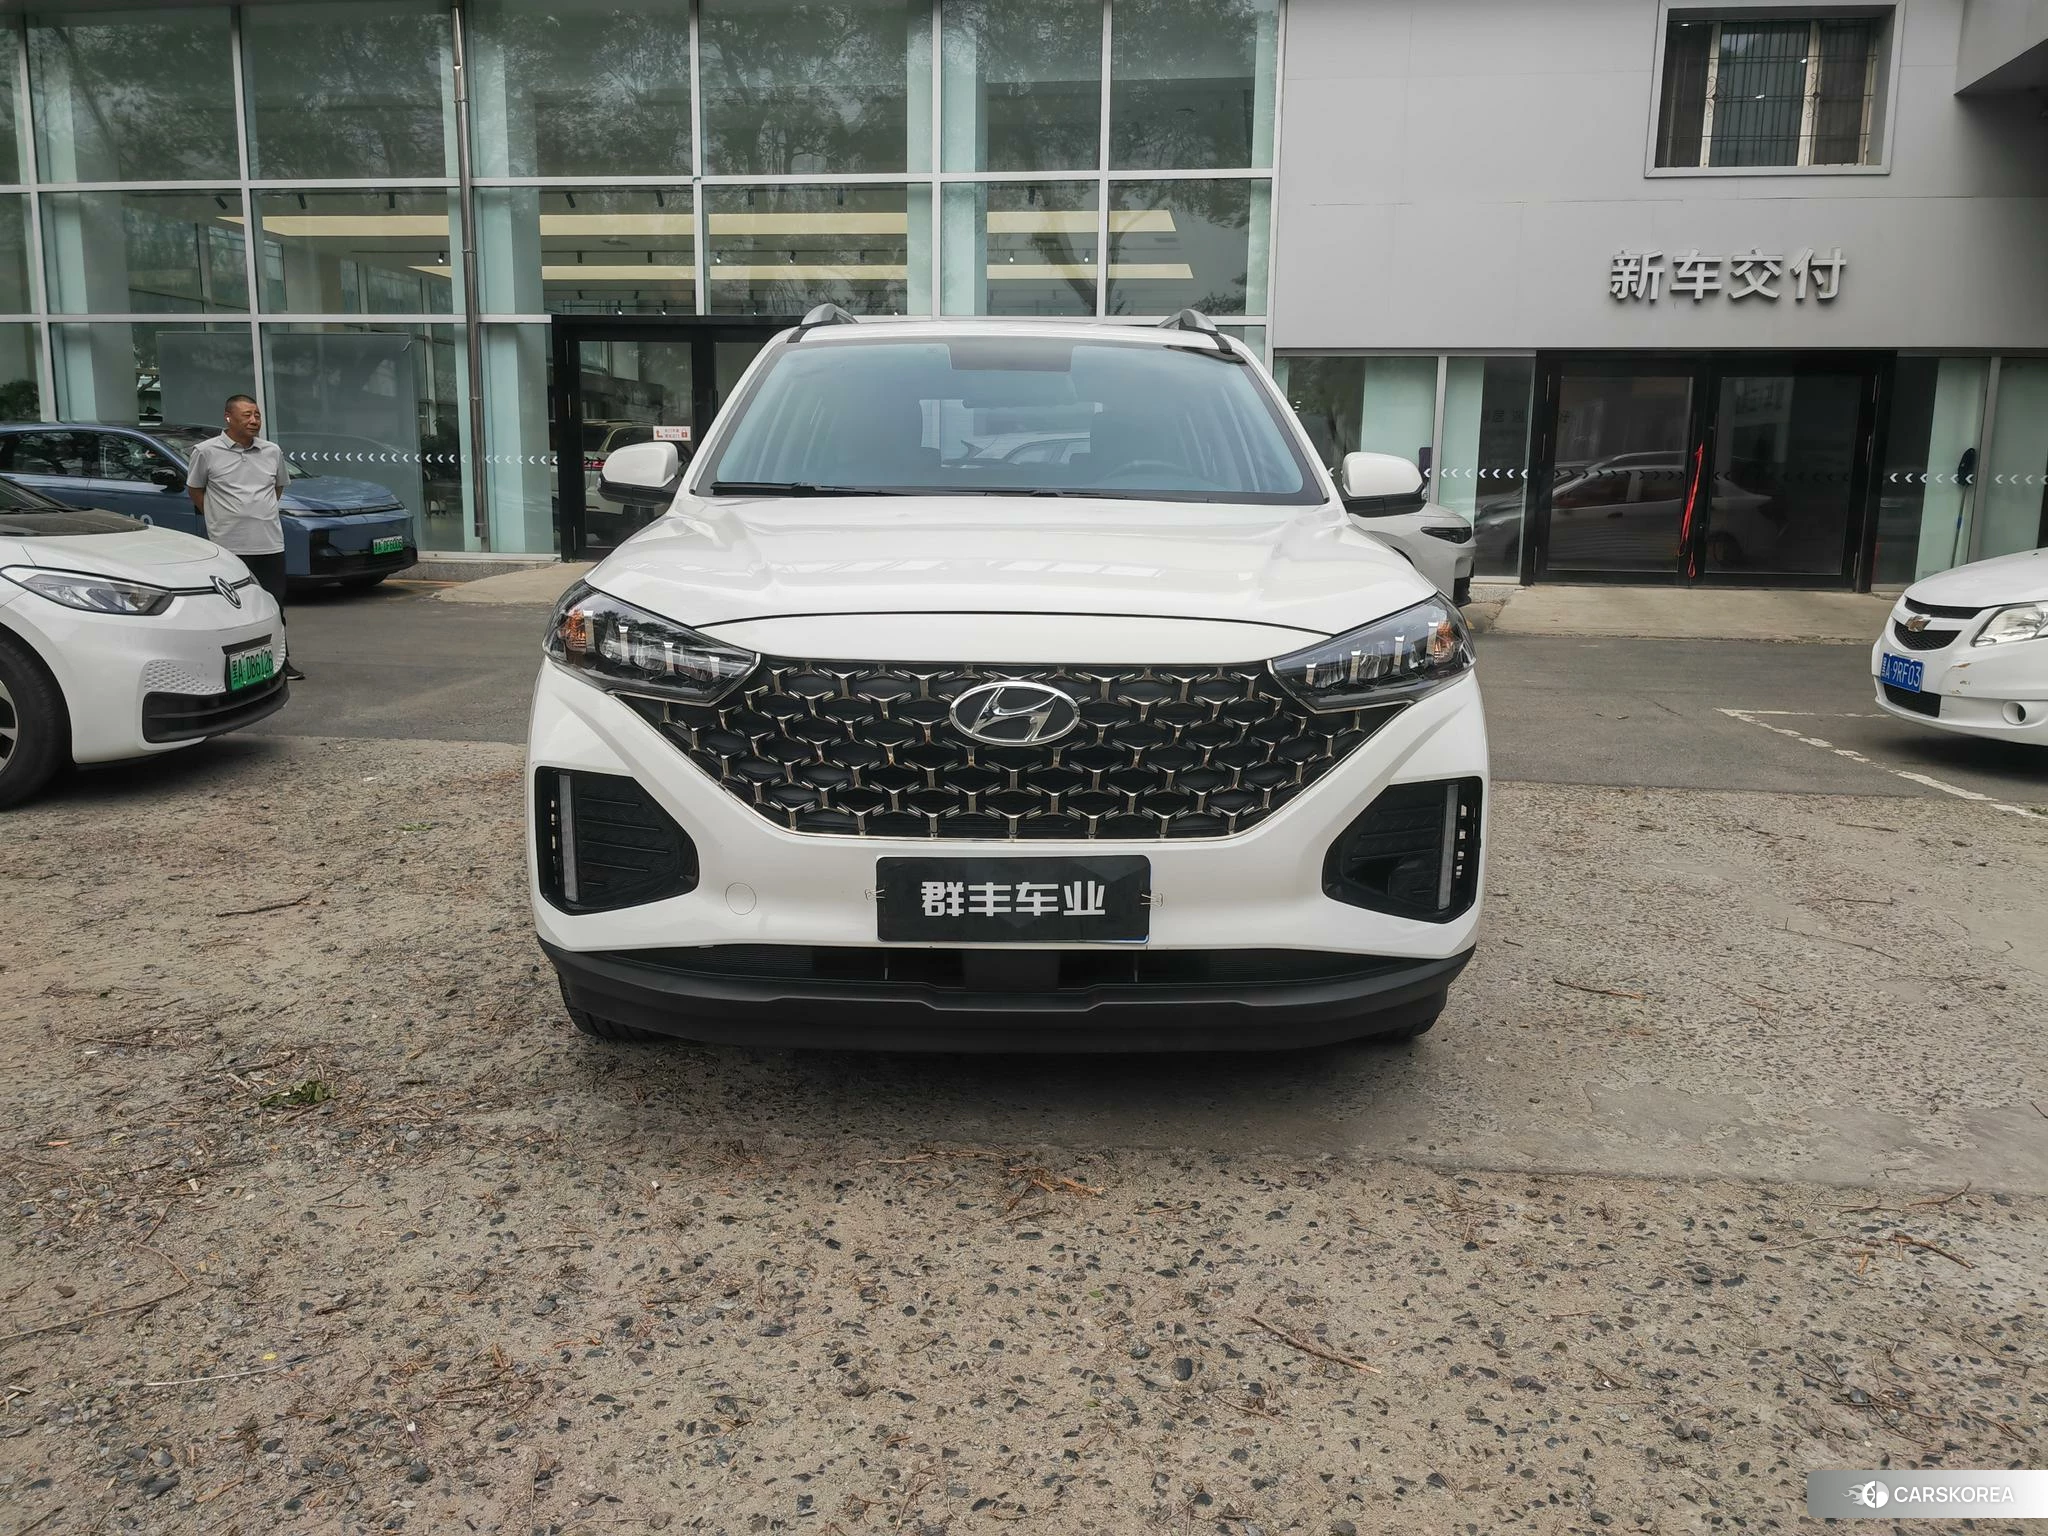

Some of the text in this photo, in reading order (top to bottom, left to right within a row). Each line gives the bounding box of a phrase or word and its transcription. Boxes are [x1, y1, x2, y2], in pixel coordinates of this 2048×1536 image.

[1609, 248, 1847, 301] 新车交付
[920, 880, 1106, 917] 群丰车业
